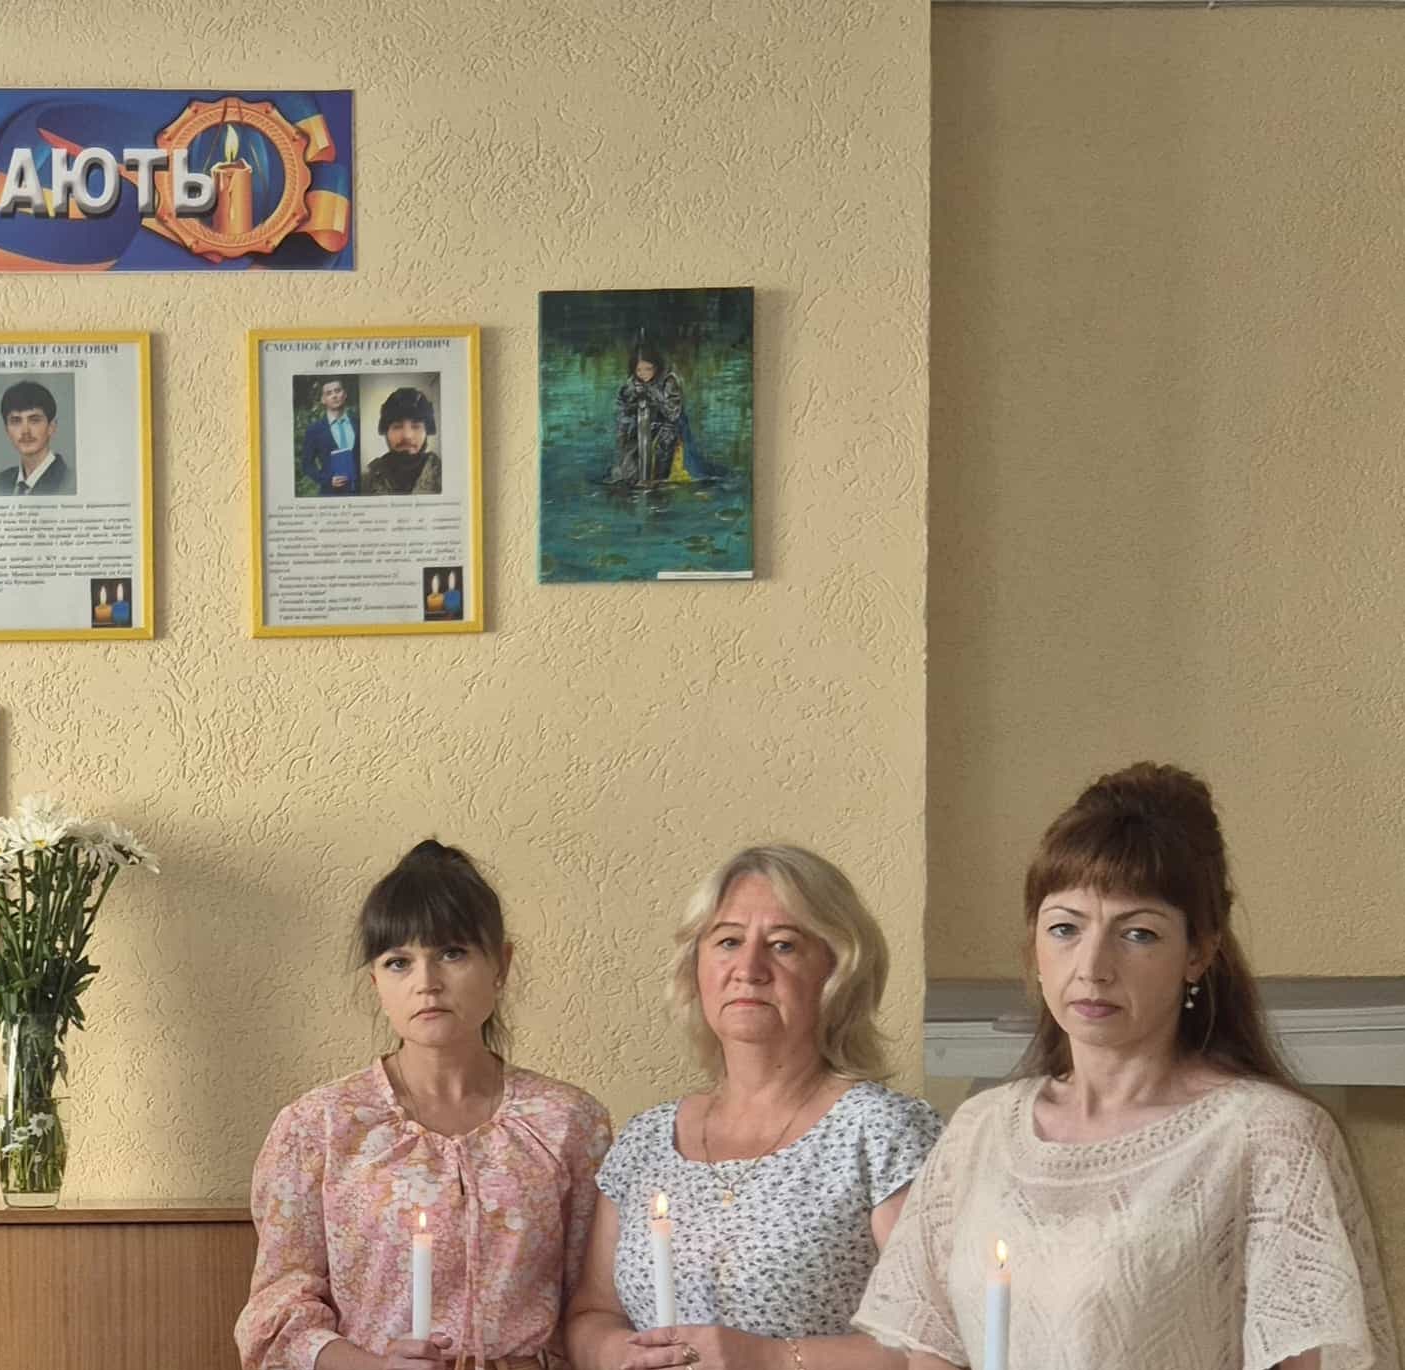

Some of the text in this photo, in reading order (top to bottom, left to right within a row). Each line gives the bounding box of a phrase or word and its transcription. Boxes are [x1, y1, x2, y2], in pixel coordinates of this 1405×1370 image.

[16, 345, 48, 356] ОЛЕГ
[51, 344, 118, 355] ОЛЕГОВИЧ
[325, 341, 366, 351] АРТЕМ
